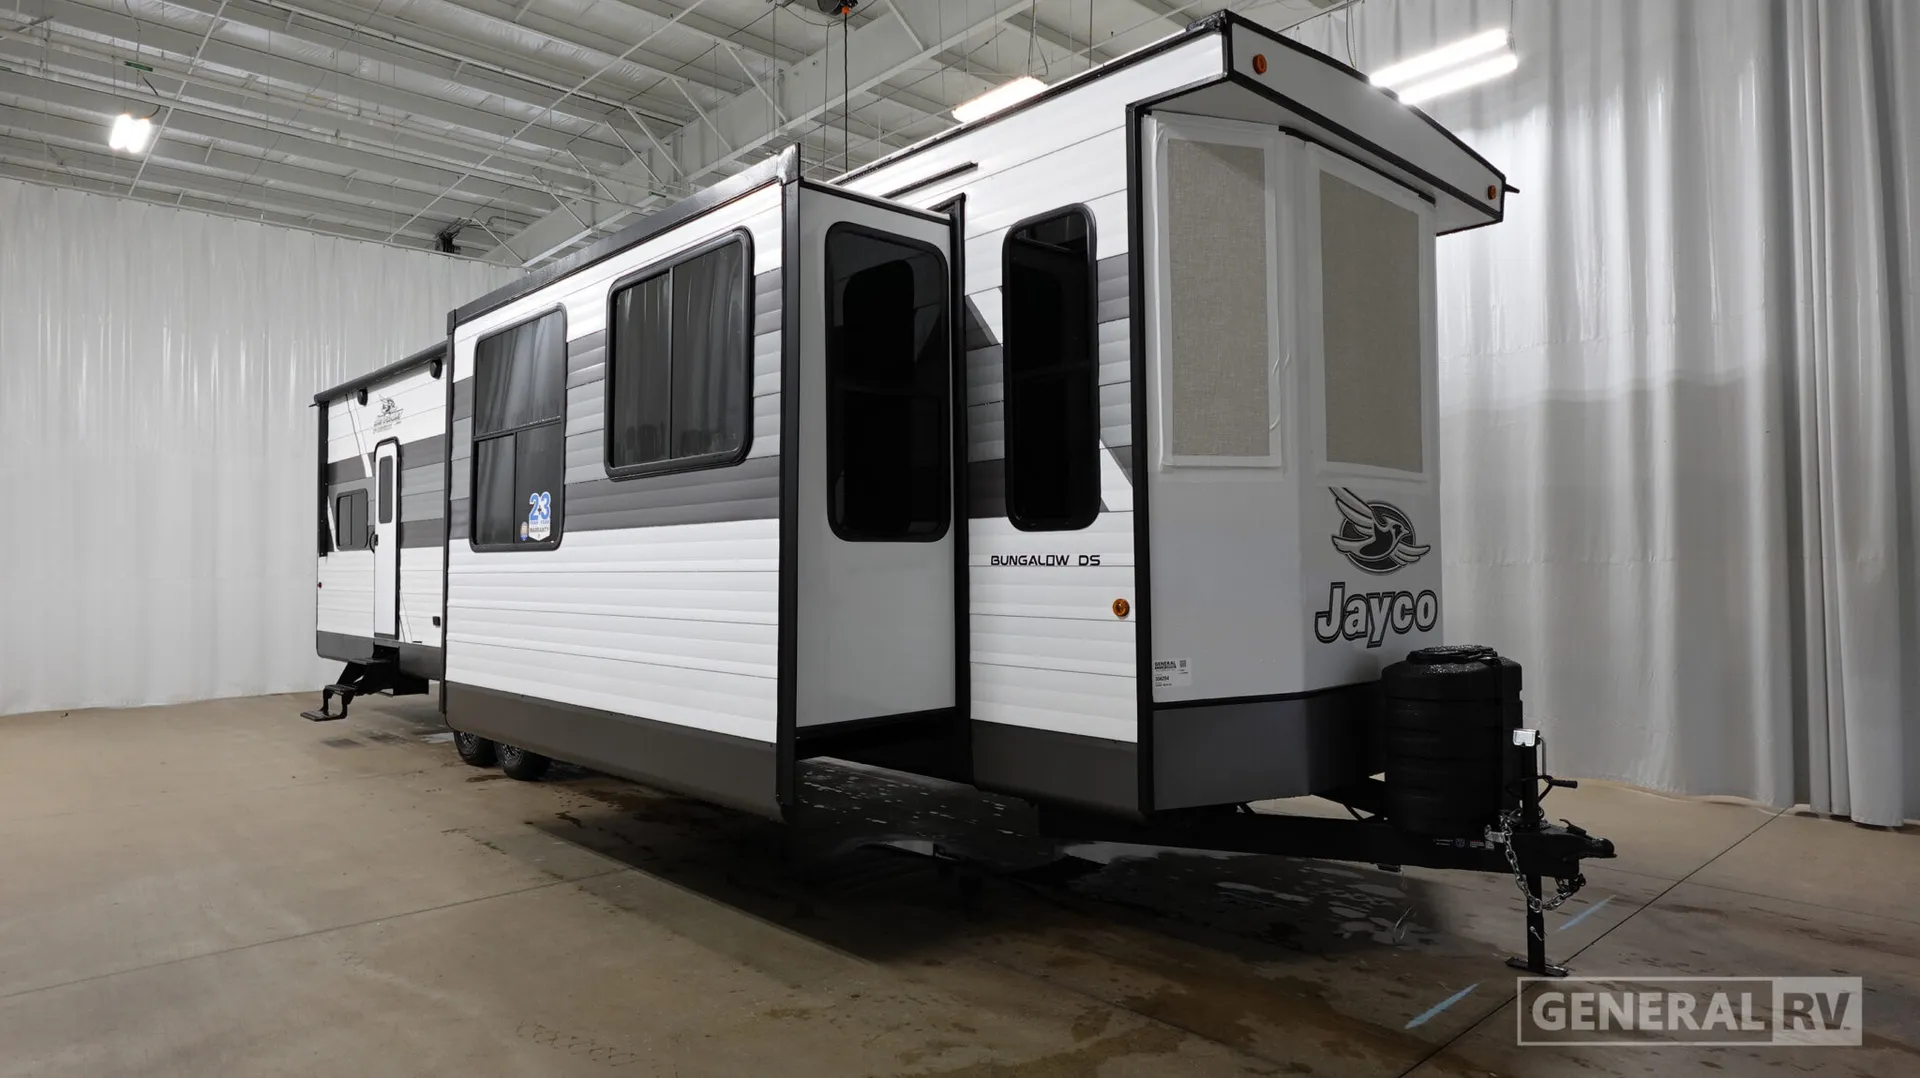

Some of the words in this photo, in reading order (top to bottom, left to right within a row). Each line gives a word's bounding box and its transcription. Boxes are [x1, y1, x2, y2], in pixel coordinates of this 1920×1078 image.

[990, 555, 1069, 566] BUNGALOW
[1079, 555, 1101, 566] DS
[1315, 582, 1438, 648] Jayco
